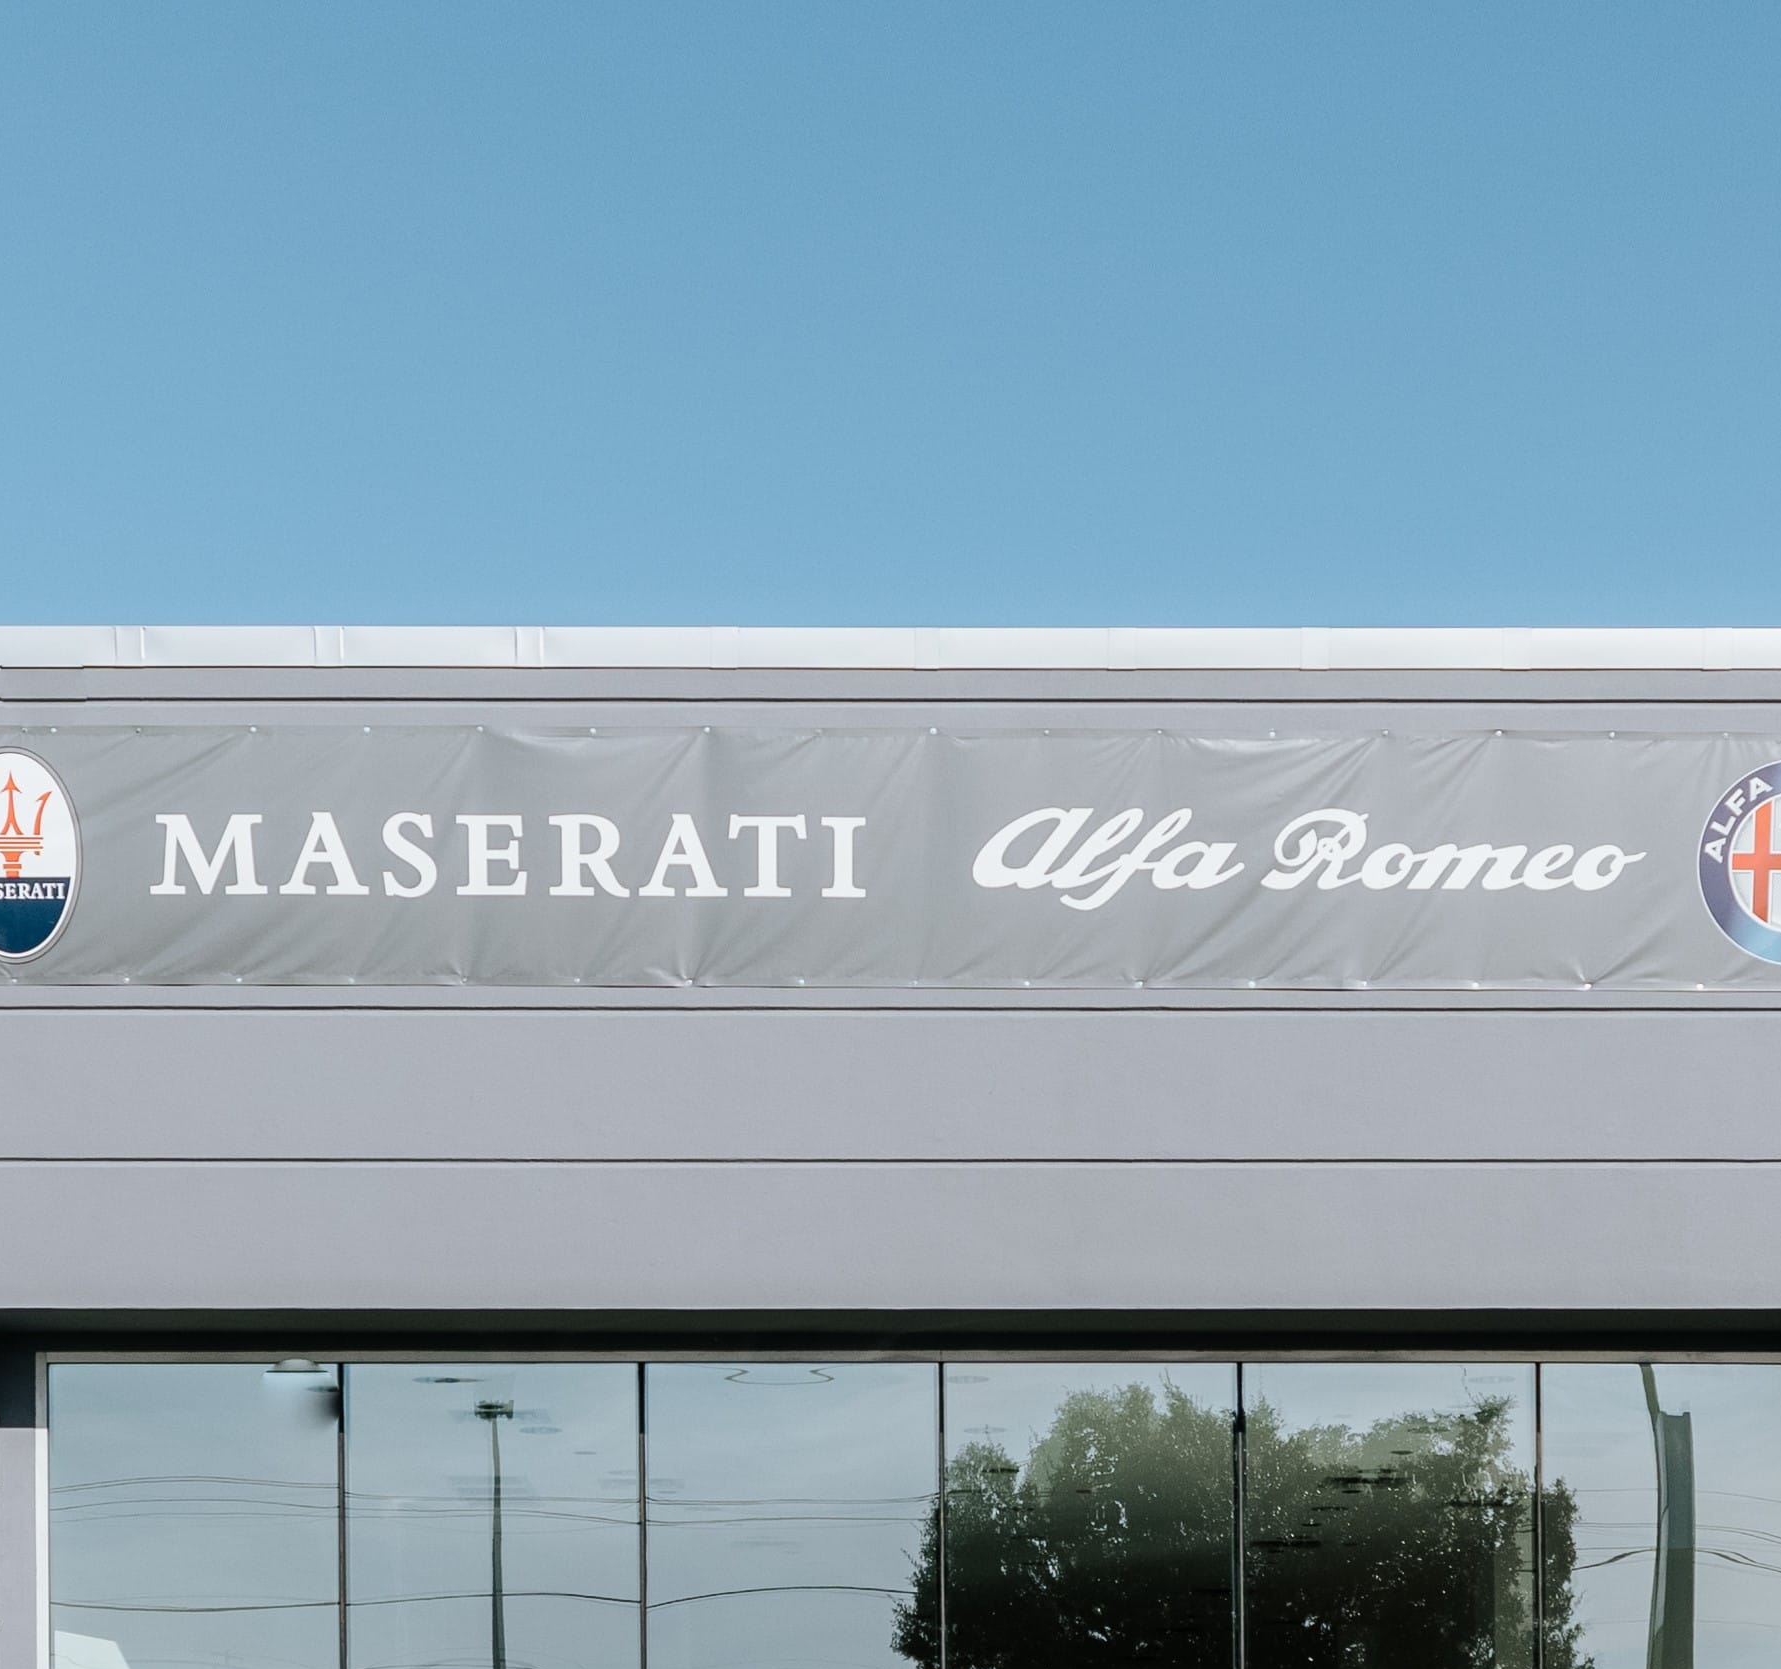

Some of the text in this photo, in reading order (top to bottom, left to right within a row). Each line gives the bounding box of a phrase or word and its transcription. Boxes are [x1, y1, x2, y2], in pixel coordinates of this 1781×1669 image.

[149, 811, 867, 899] MASERATI
[971, 807, 1648, 912] Alfa Romeo
[1703, 776, 1773, 864] ALFA
